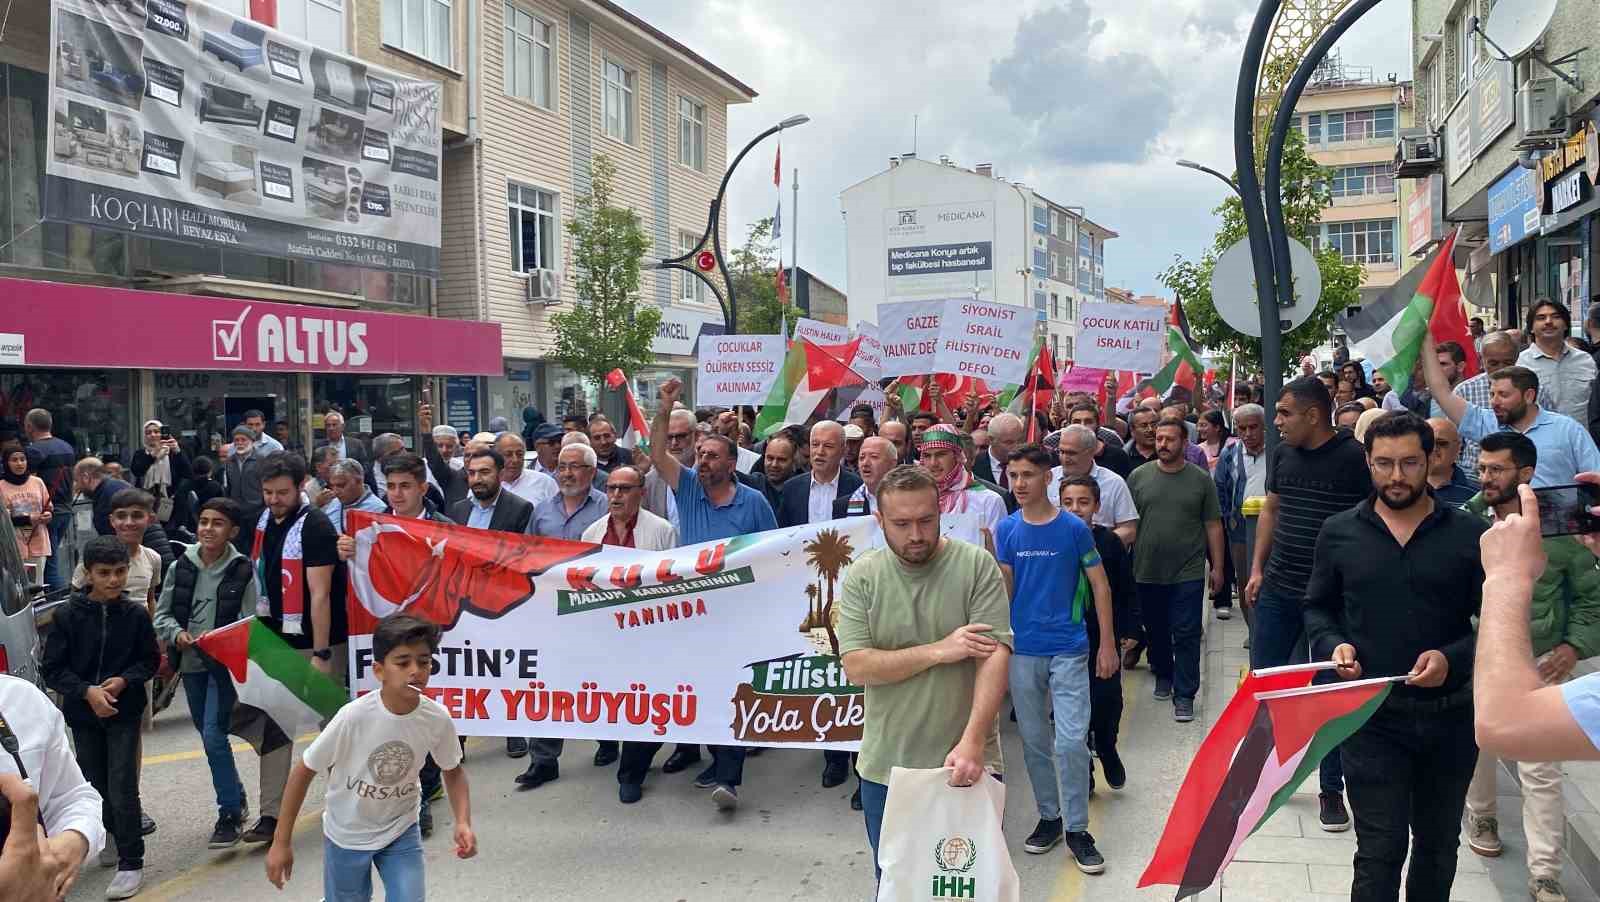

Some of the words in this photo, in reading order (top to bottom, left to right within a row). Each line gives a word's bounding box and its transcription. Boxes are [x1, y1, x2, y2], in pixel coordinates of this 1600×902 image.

[1551, 172, 1581, 214] MARKET
[89, 193, 173, 230] KOÇLAR
[937, 210, 985, 222] MEDICANA
[336, 234, 359, 248] 0332
[891, 249, 930, 259] Medicana
[931, 248, 957, 258] Konya
[959, 246, 978, 255] artık
[905, 260, 940, 270] fakültesi
[942, 257, 986, 267] hastanesi!
[960, 303, 1016, 321] SİYONİST
[907, 316, 939, 330] GAZZE
[966, 323, 1003, 337] İSRAİL
[1082, 317, 1120, 329] ÇOCUK
[1123, 319, 1159, 332] KATİLİ
[258, 313, 368, 366] ALTUS
[1097, 336, 1132, 349] İSRAİL
[717, 342, 762, 355] ÇOCUKLAR
[883, 342, 916, 358] YALNIZ
[945, 340, 1021, 361] FİLİSTİN'DEN
[705, 359, 744, 373] ÖLÜRKEN
[746, 359, 775, 373] SESSİZ
[958, 361, 996, 376] DEFOL
[716, 382, 761, 393] KALINMAZ
[565, 543, 726, 592] KULU
[568, 589, 627, 608] MAZLUM
[614, 598, 707, 629] YANINDA
[500, 681, 697, 736] YÜRÜYÜŞÜ
[738, 698, 804, 740] Yola
